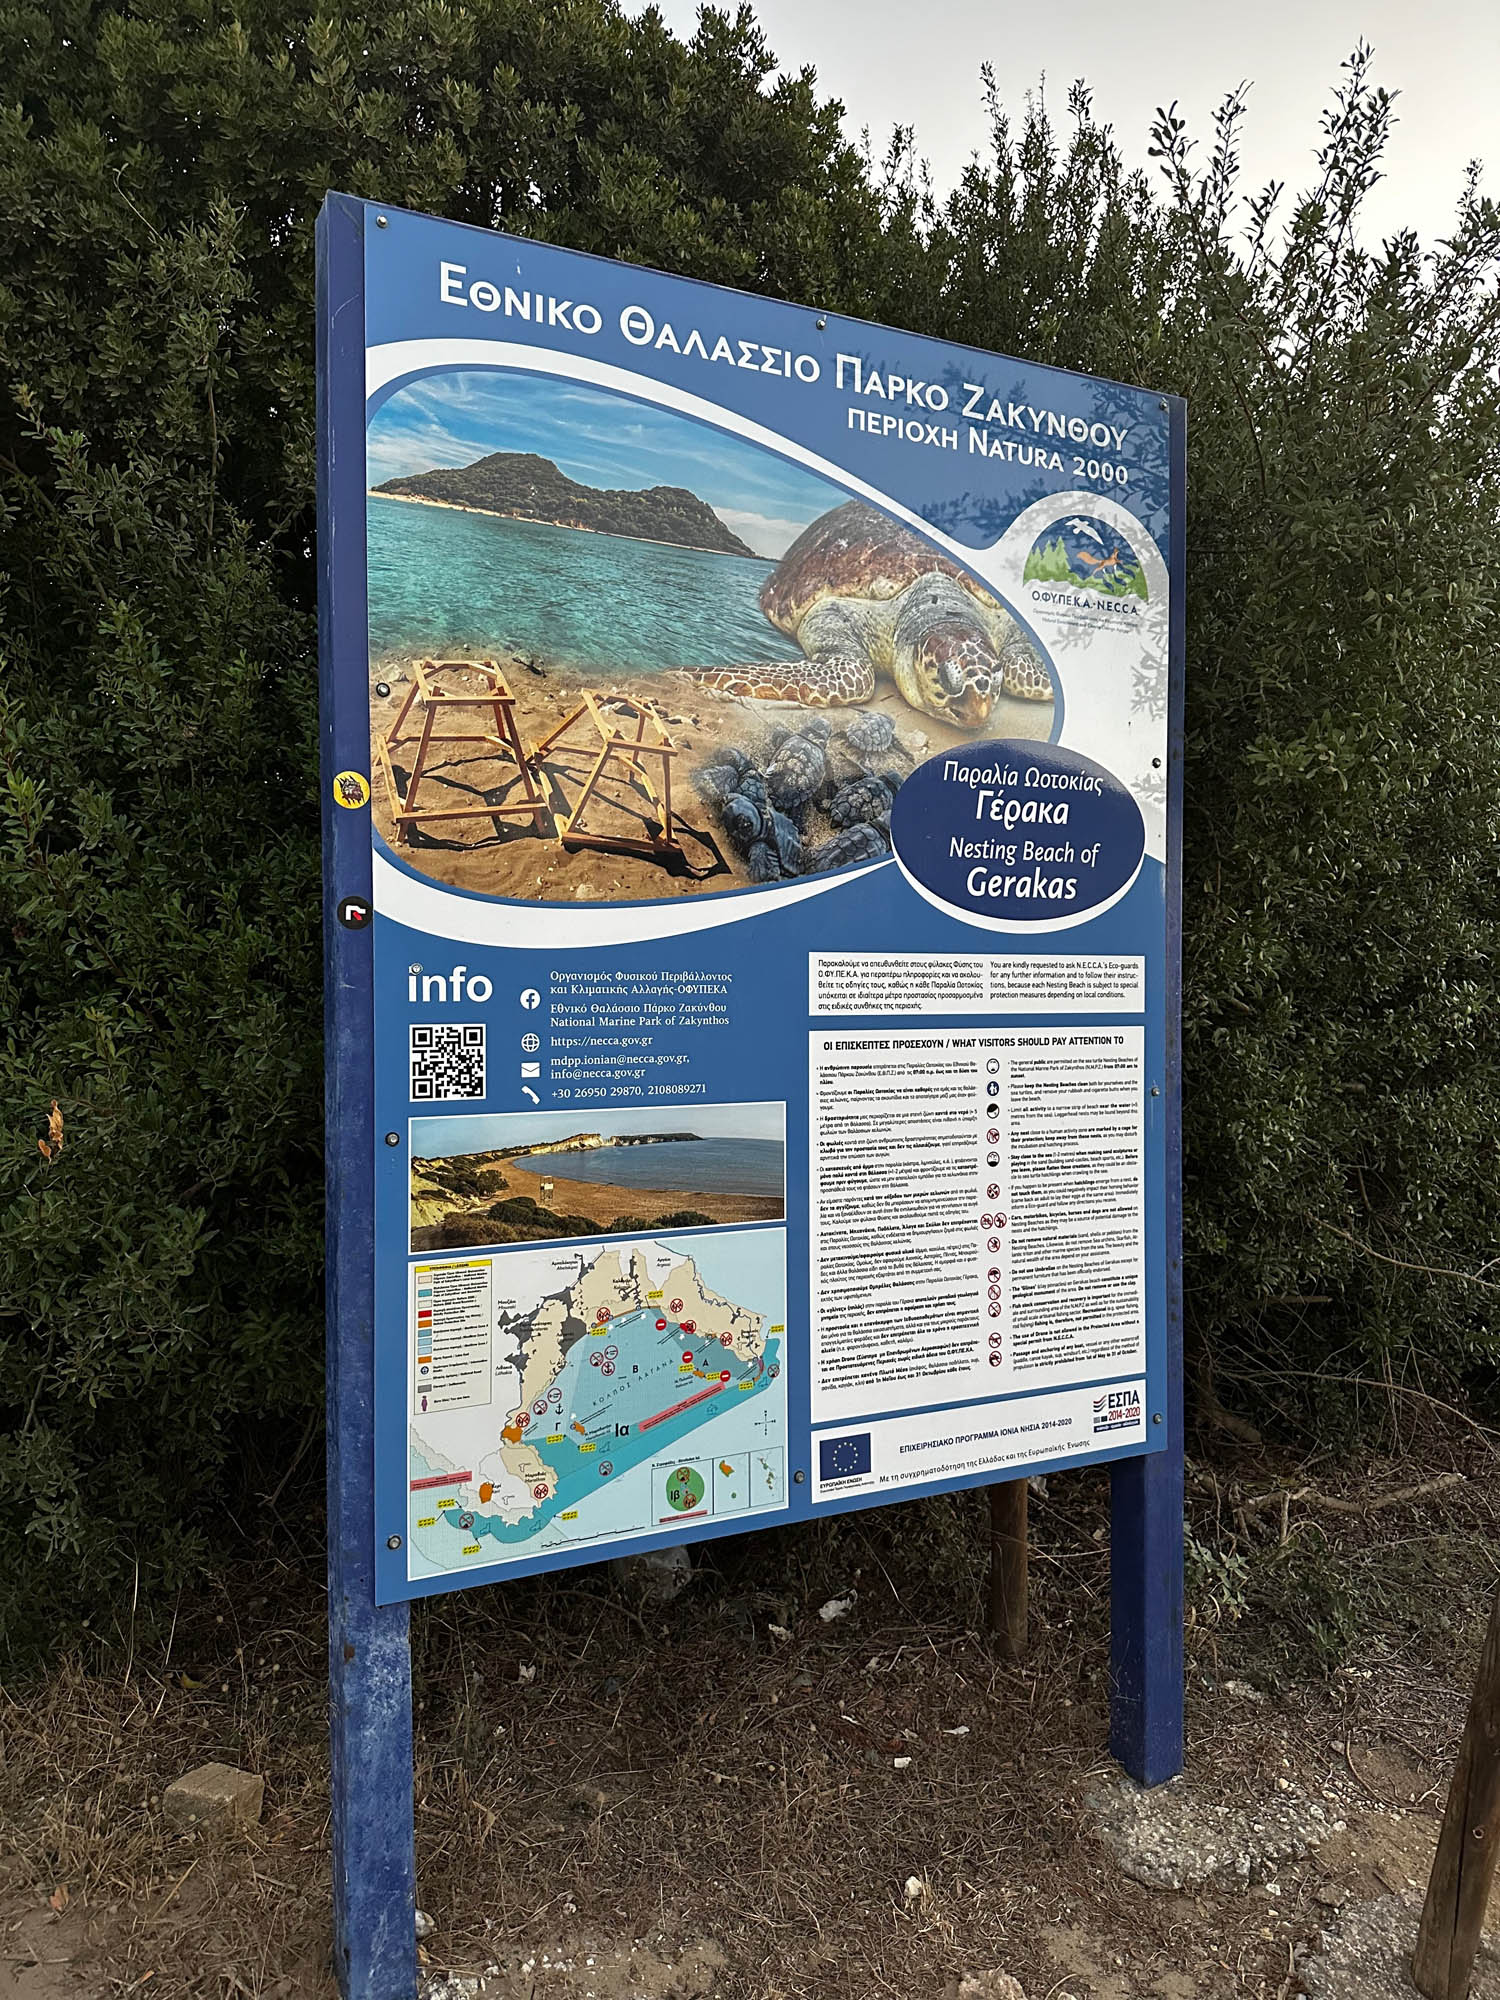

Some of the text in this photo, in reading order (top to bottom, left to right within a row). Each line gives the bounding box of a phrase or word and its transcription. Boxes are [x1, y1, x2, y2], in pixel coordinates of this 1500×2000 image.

[848, 408, 958, 450] ΠΕΡΙΟΧΗ
[1072, 456, 1128, 485] 2000
[944, 760, 1104, 796] Παραλία Ωοτοκίας
[976, 790, 1070, 830] Γέρακα
[950, 836, 1101, 868] Nesting Beach of
[966, 866, 1078, 900] Gerakas
[408, 963, 494, 1002] info
[550, 971, 732, 983] Οργανισμός Φυσικού Περιβάλλοντος
[571, 984, 627, 996] Κλιματικής
[550, 1002, 726, 1014] Εθνικό Θαλάσσιο Πάρκο Ζακύνθου
[550, 1015, 729, 1027] National Marine Park of Zakynthos
[550, 1036, 652, 1048] https://necca.gov.gr
[823, 1041, 832, 1050] ΟΙ
[835, 1040, 890, 1050] ΕΠΙΣΚΕΠΤΕΣ
[892, 1039, 943, 1048] ΠΡΟΣΕΧΟΥΝ
[952, 1038, 976, 1047] WHAT
[978, 1038, 1015, 1047] VISITORS
[1017, 1037, 1049, 1046] SHOULD
[1052, 1036, 1066, 1045] PAY
[1068, 1036, 1111, 1045] ATTENTION
[1113, 1036, 1123, 1044] TO
[551, 1069, 645, 1080] info@necca.gov.gr
[551, 1084, 705, 1098] +30 26950 29870, 2108089271
[1108, 1390, 1140, 1408] ΕΣΠΑ
[1108, 1406, 1140, 1421] 2014-2020
